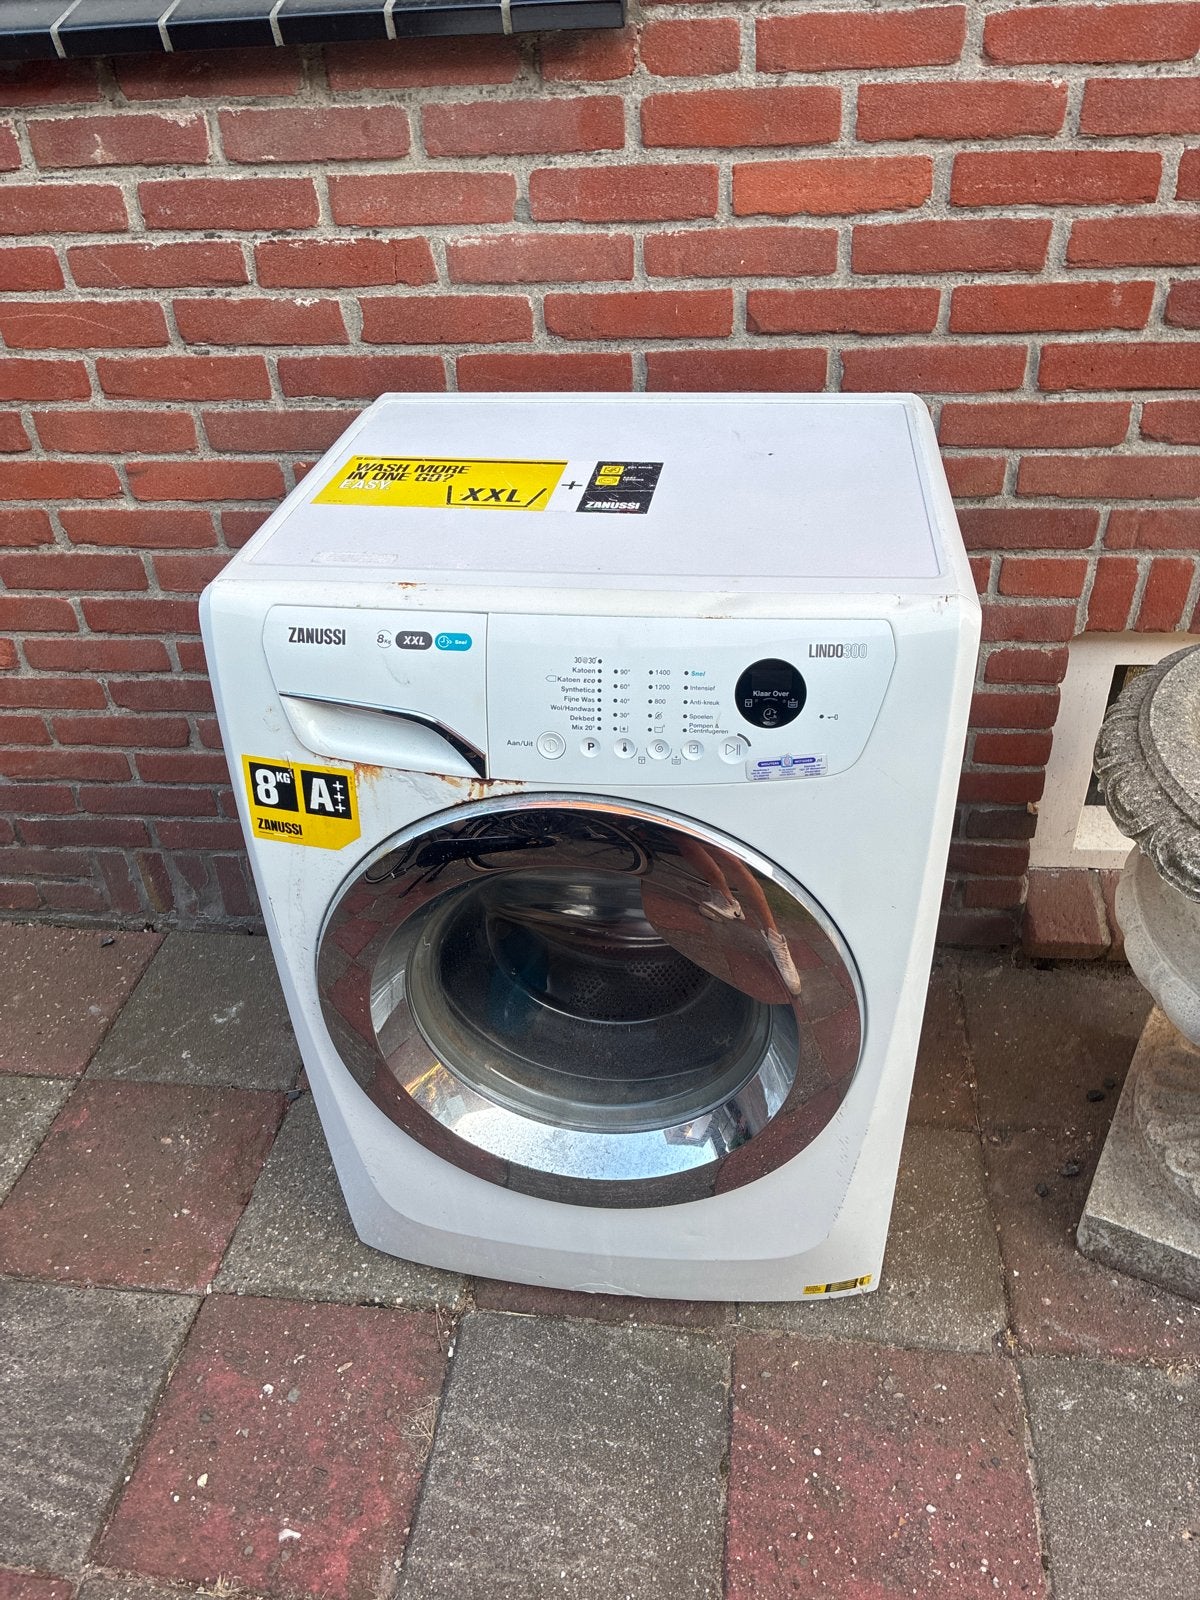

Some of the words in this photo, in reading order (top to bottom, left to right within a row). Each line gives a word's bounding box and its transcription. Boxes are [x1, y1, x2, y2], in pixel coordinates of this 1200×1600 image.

[356, 463, 410, 472] WASH
[414, 465, 471, 474] MORE
[347, 471, 367, 480] IN
[372, 473, 411, 481] ONE
[415, 474, 454, 482] GO?
[462, 488, 520, 502] XXL
[288, 627, 346, 645] ZANUSSI
[403, 636, 425, 646] XXL
[808, 643, 867, 658] LINDO300
[688, 722, 713, 730] Pompen
[587, 742, 595, 751] P
[257, 817, 303, 836] ZANUSSI
